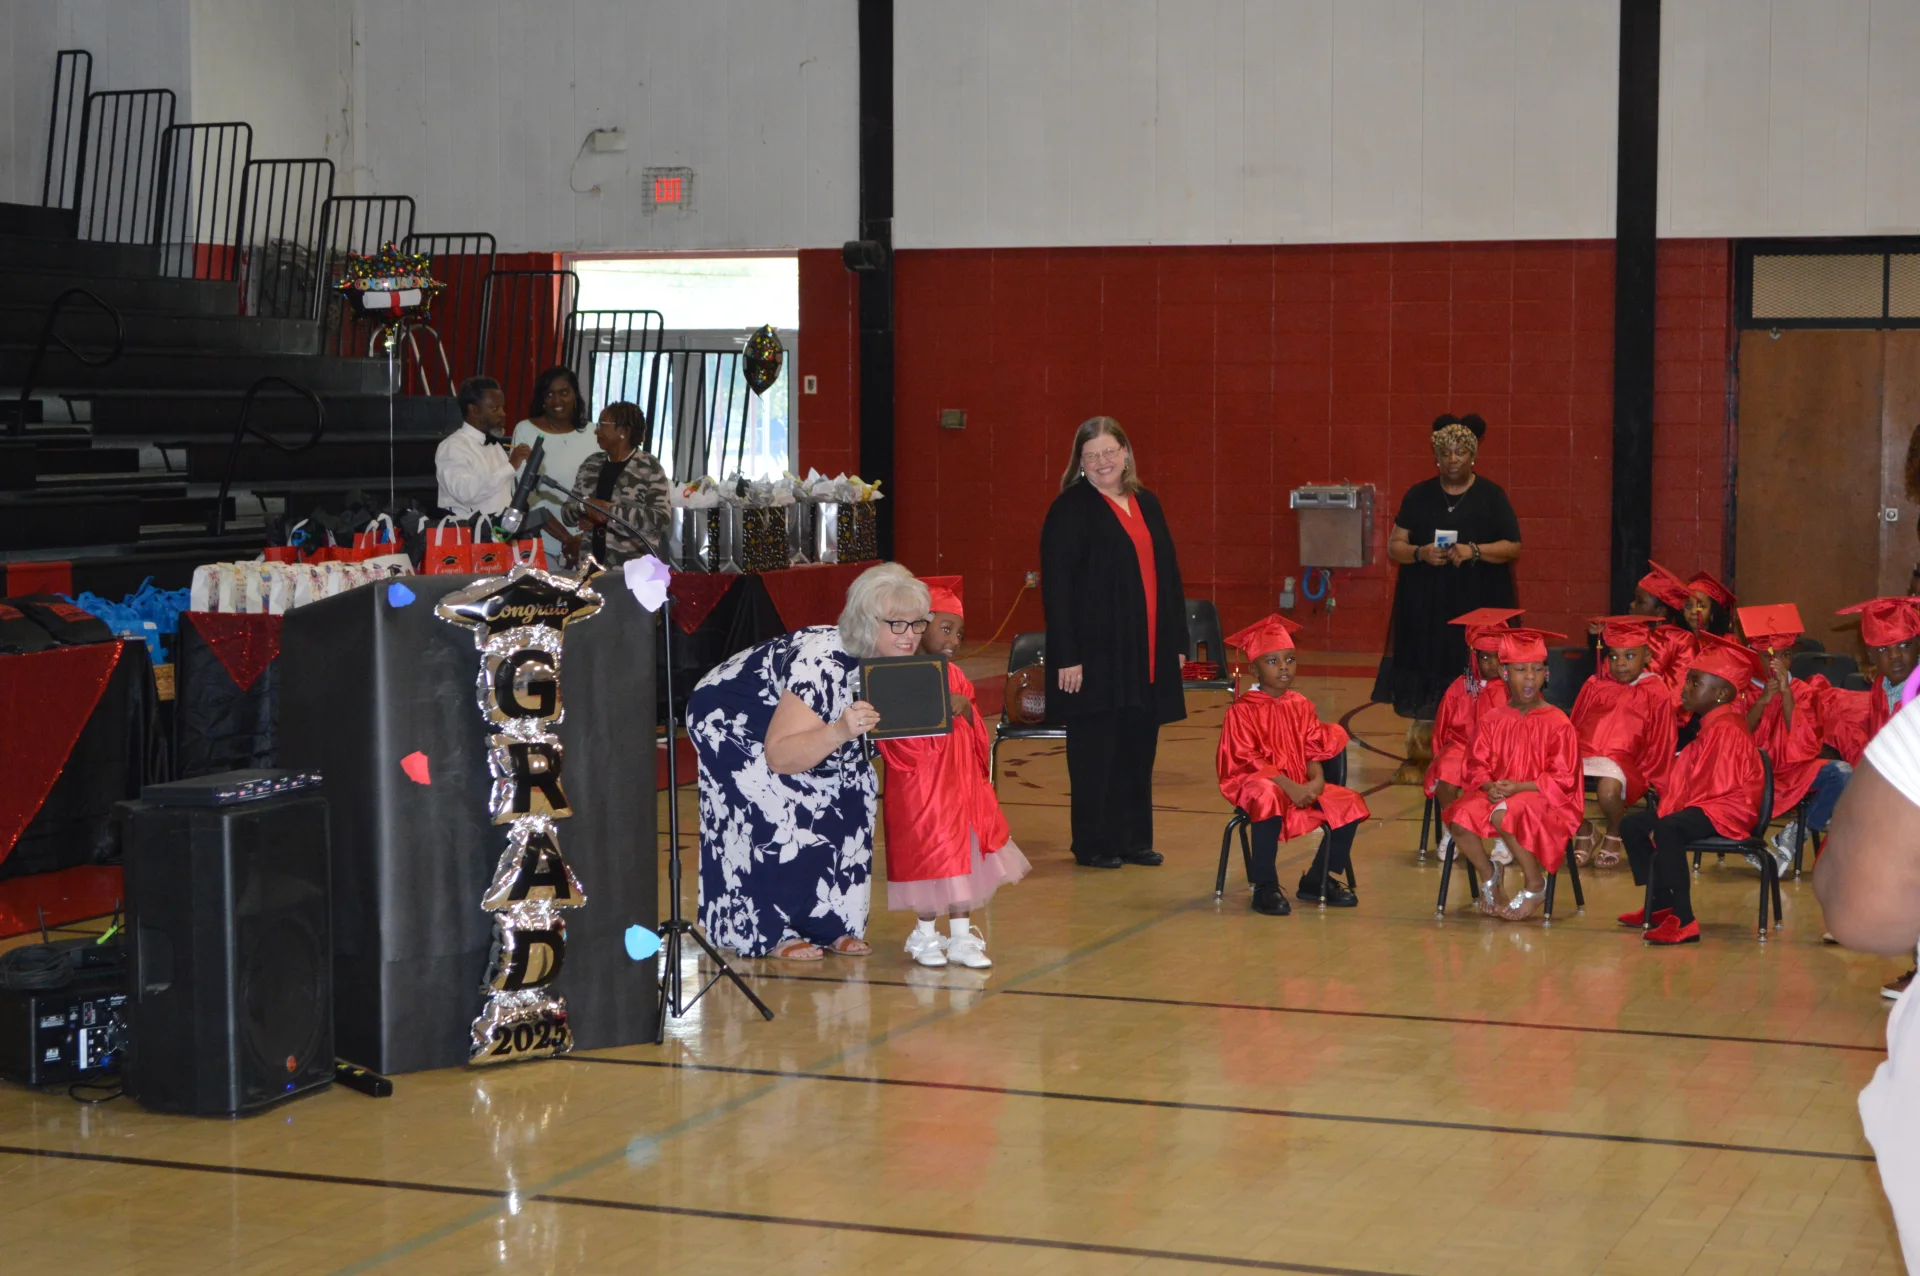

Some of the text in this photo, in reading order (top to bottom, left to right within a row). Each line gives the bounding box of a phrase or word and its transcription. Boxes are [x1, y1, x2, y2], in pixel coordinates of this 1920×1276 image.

[656, 177, 682, 202] EXIT
[482, 595, 569, 624] Congrats
[491, 1019, 567, 1056] 2025
